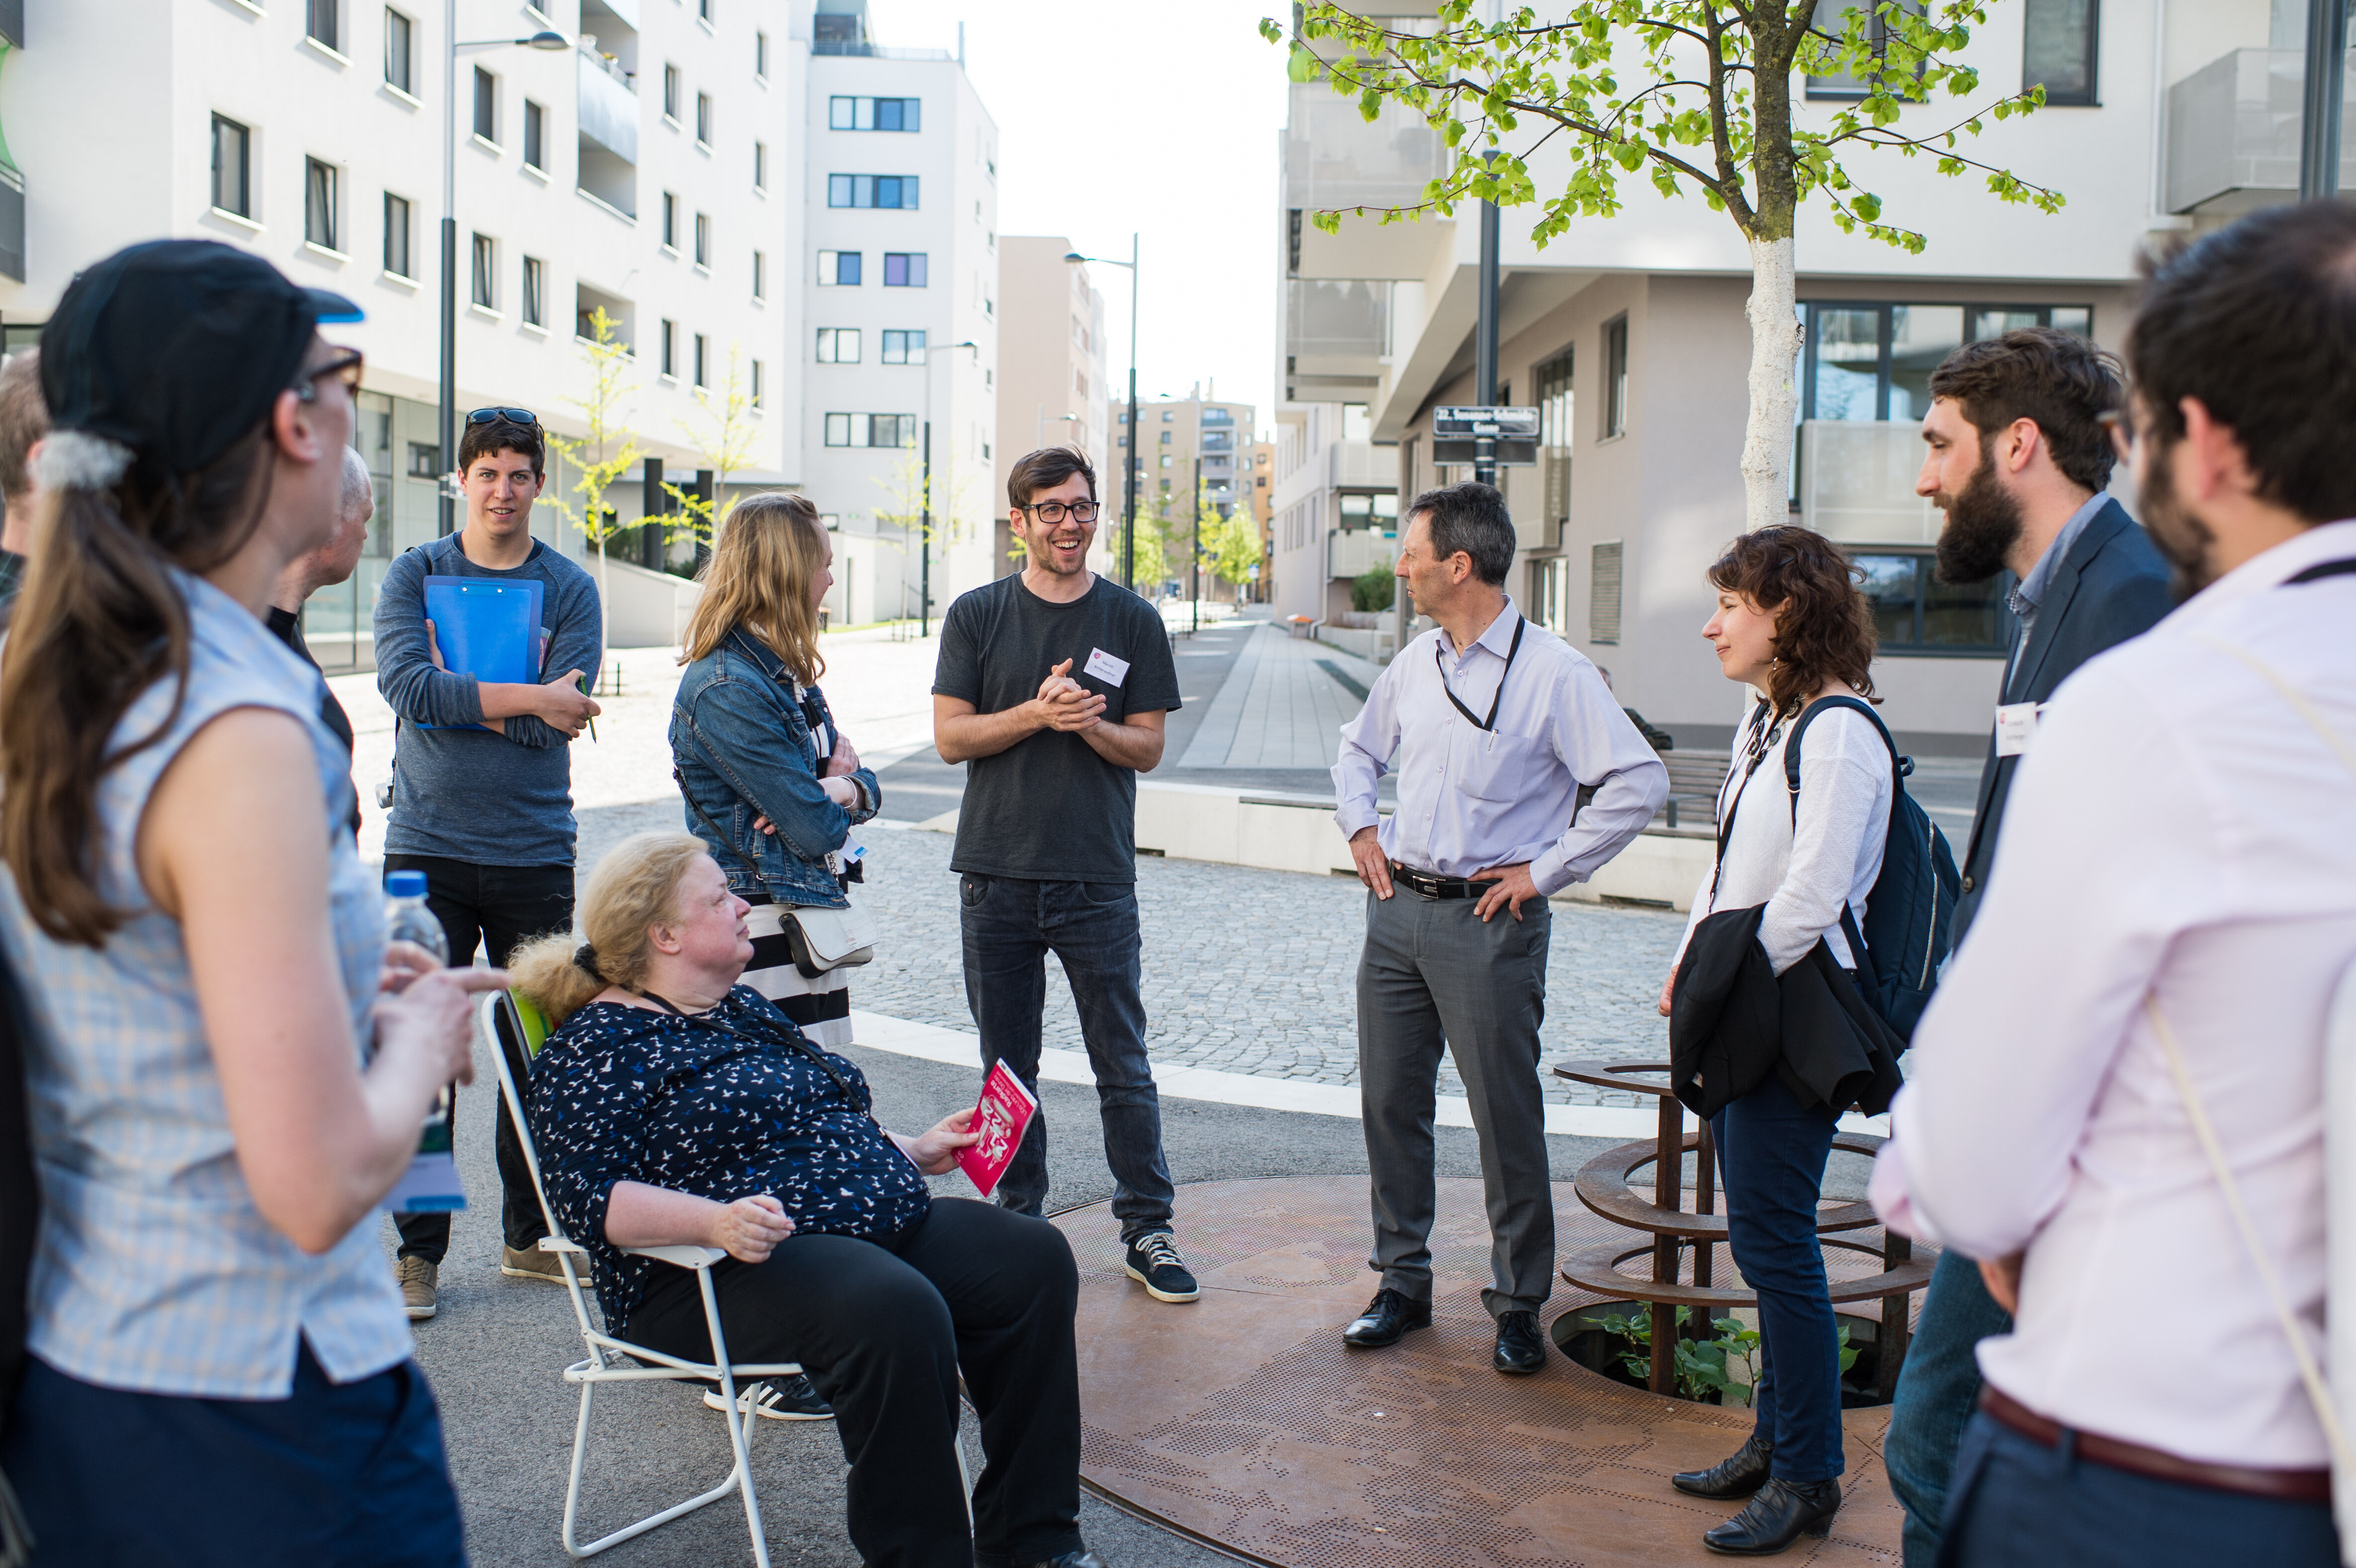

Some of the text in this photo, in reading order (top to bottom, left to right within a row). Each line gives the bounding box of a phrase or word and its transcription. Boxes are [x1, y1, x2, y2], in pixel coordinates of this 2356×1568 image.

[1472, 421, 1500, 434] Gasse
[993, 1075, 1006, 1090] Donau
[990, 1079, 1012, 1108] Radkarte
